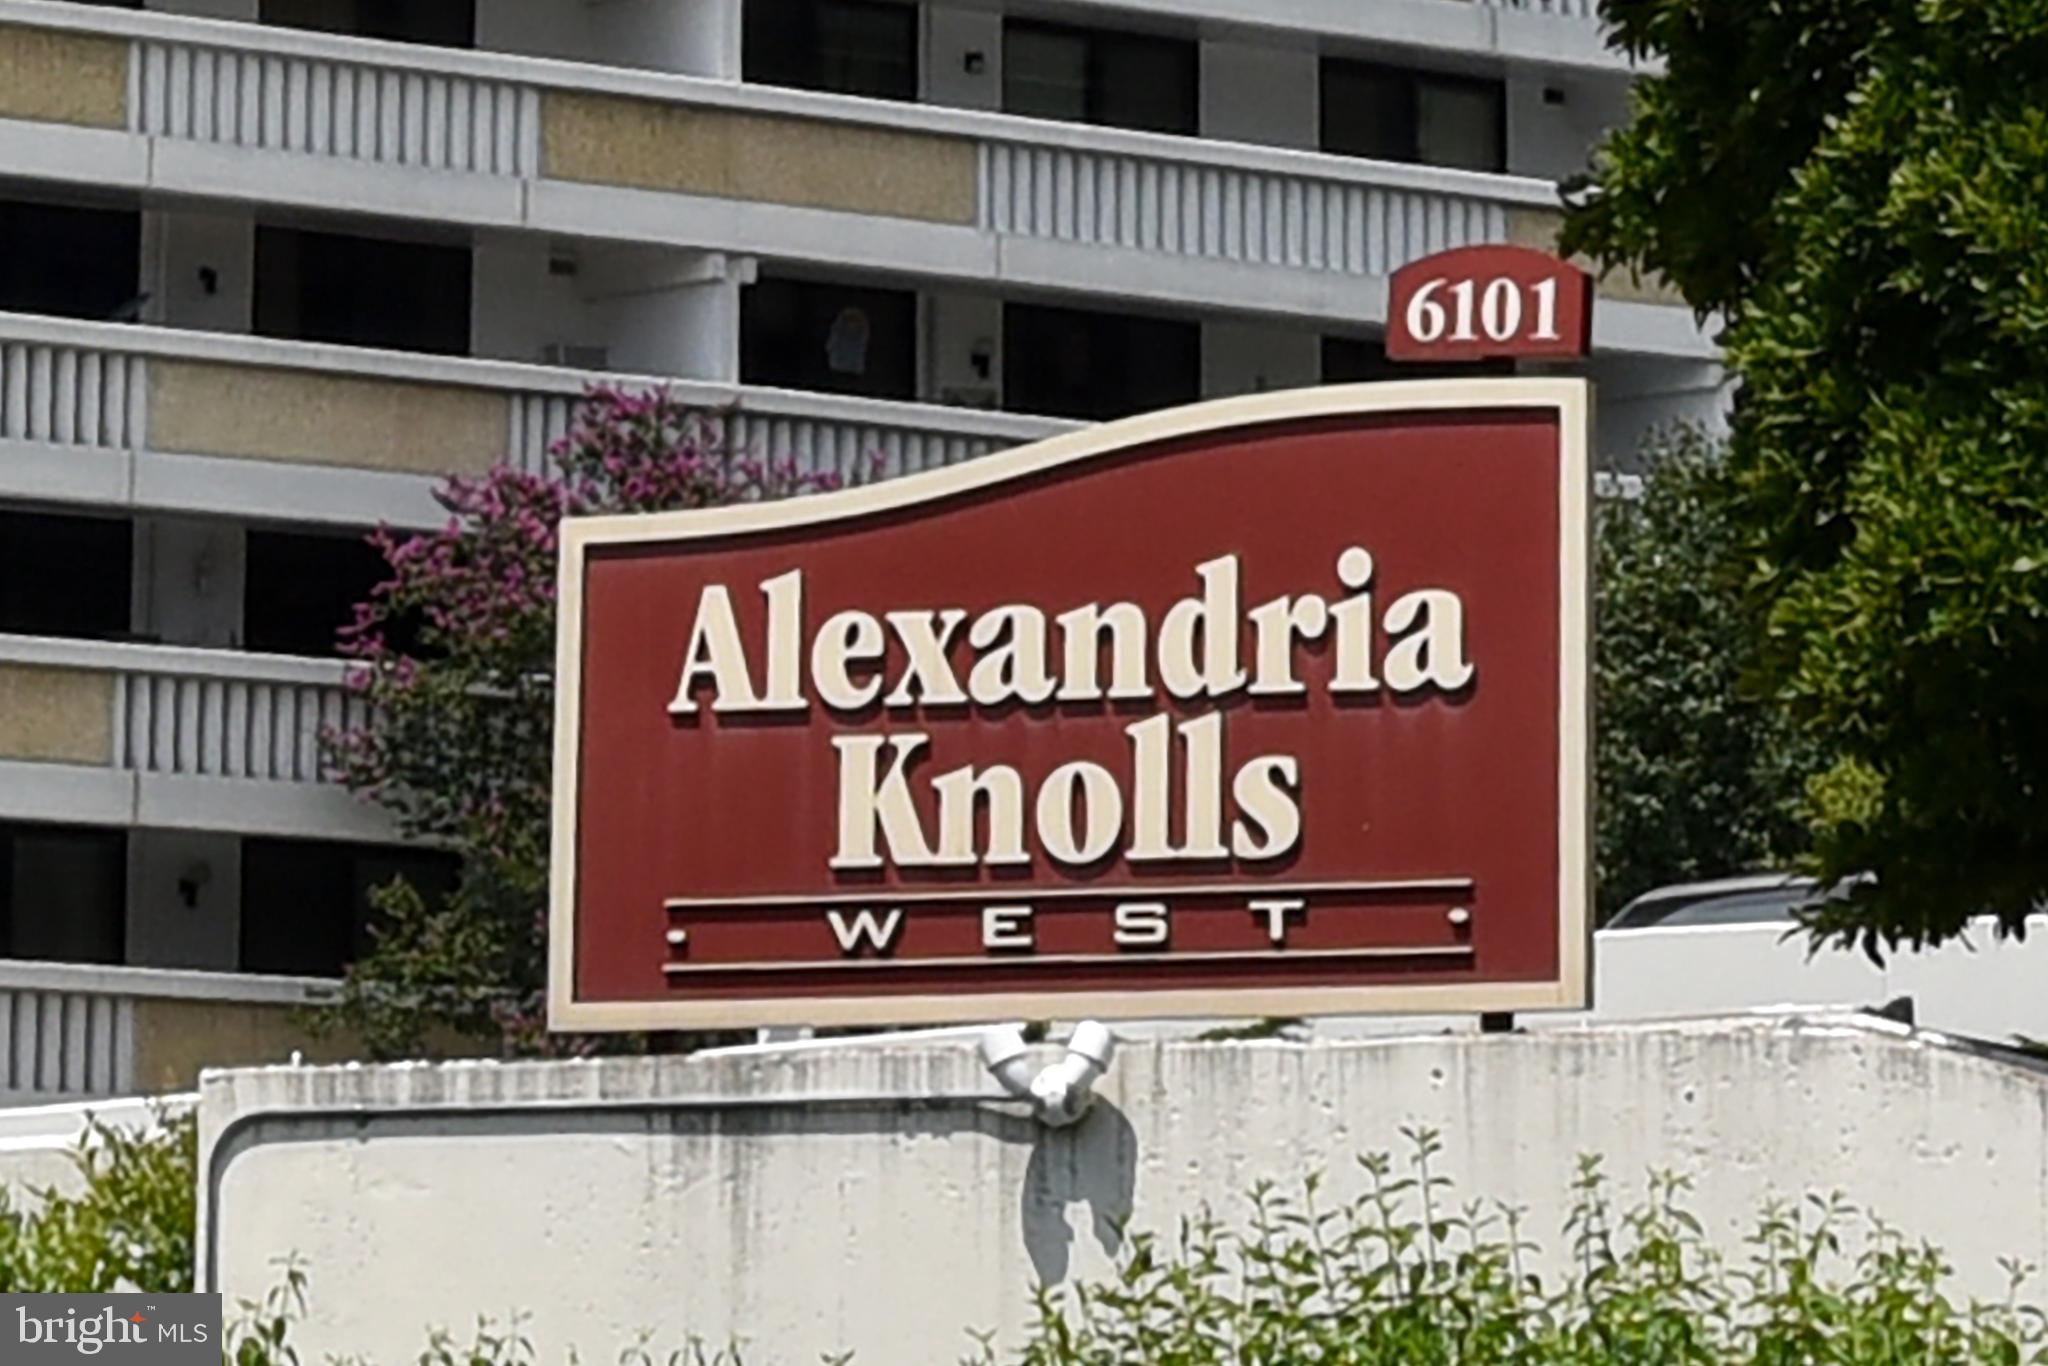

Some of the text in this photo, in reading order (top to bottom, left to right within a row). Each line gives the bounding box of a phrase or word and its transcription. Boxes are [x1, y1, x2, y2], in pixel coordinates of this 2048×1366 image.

[1406, 277, 1559, 342] 6101
[667, 547, 1474, 713] Alexandria
[829, 711, 1300, 868] Knolls
[827, 900, 1304, 950] WEST
